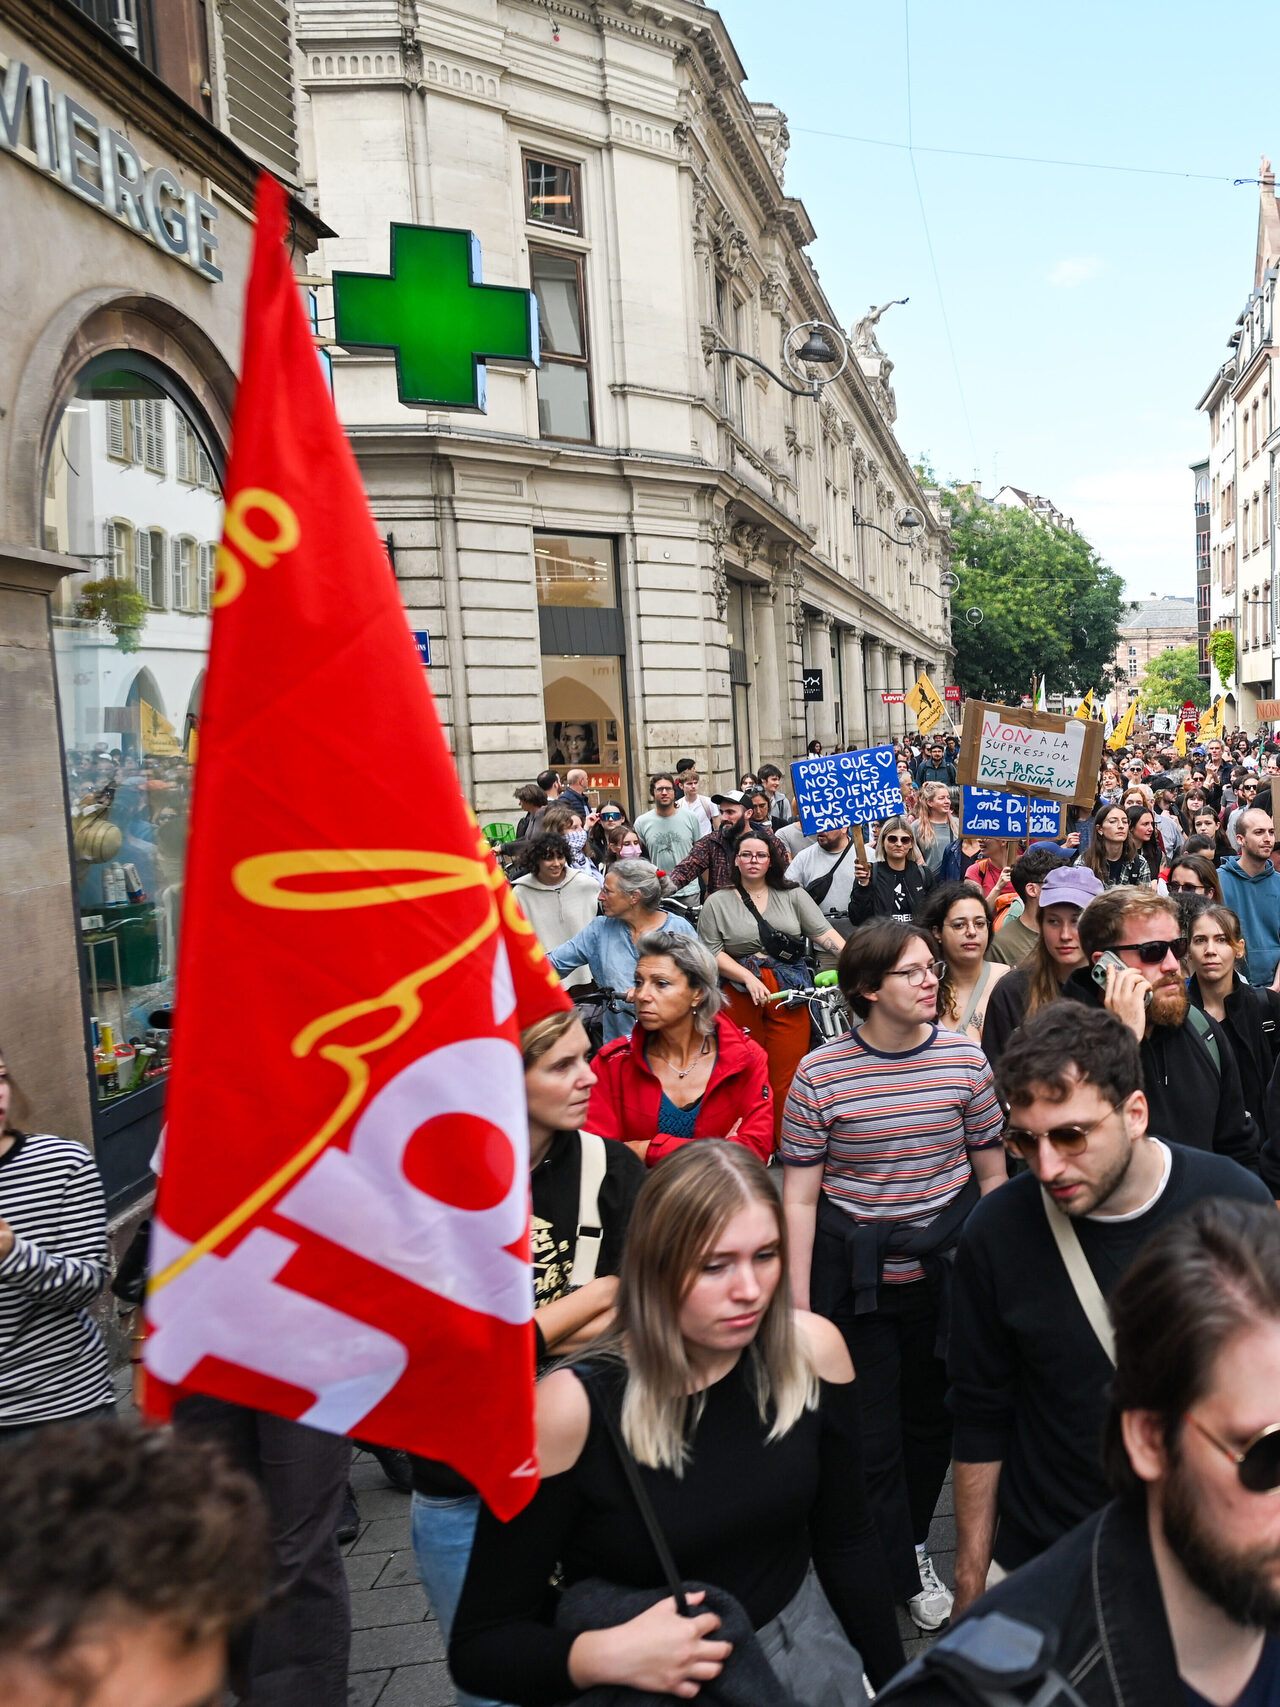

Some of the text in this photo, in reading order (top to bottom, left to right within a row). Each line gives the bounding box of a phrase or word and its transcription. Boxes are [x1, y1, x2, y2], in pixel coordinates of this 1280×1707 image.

[982, 721, 1069, 749] NON À LA
[985, 739, 1070, 762] SUPPRESSION
[799, 753, 872, 779] POUR QUE
[980, 754, 1055, 776] DES PARCS
[805, 773, 838, 789] NOS
[799, 790, 822, 803] NE
[802, 801, 843, 819] PLUS
[977, 797, 1060, 817] ont Duplomb
[816, 814, 851, 833] SANS
[966, 814, 1057, 833] dans la tête
